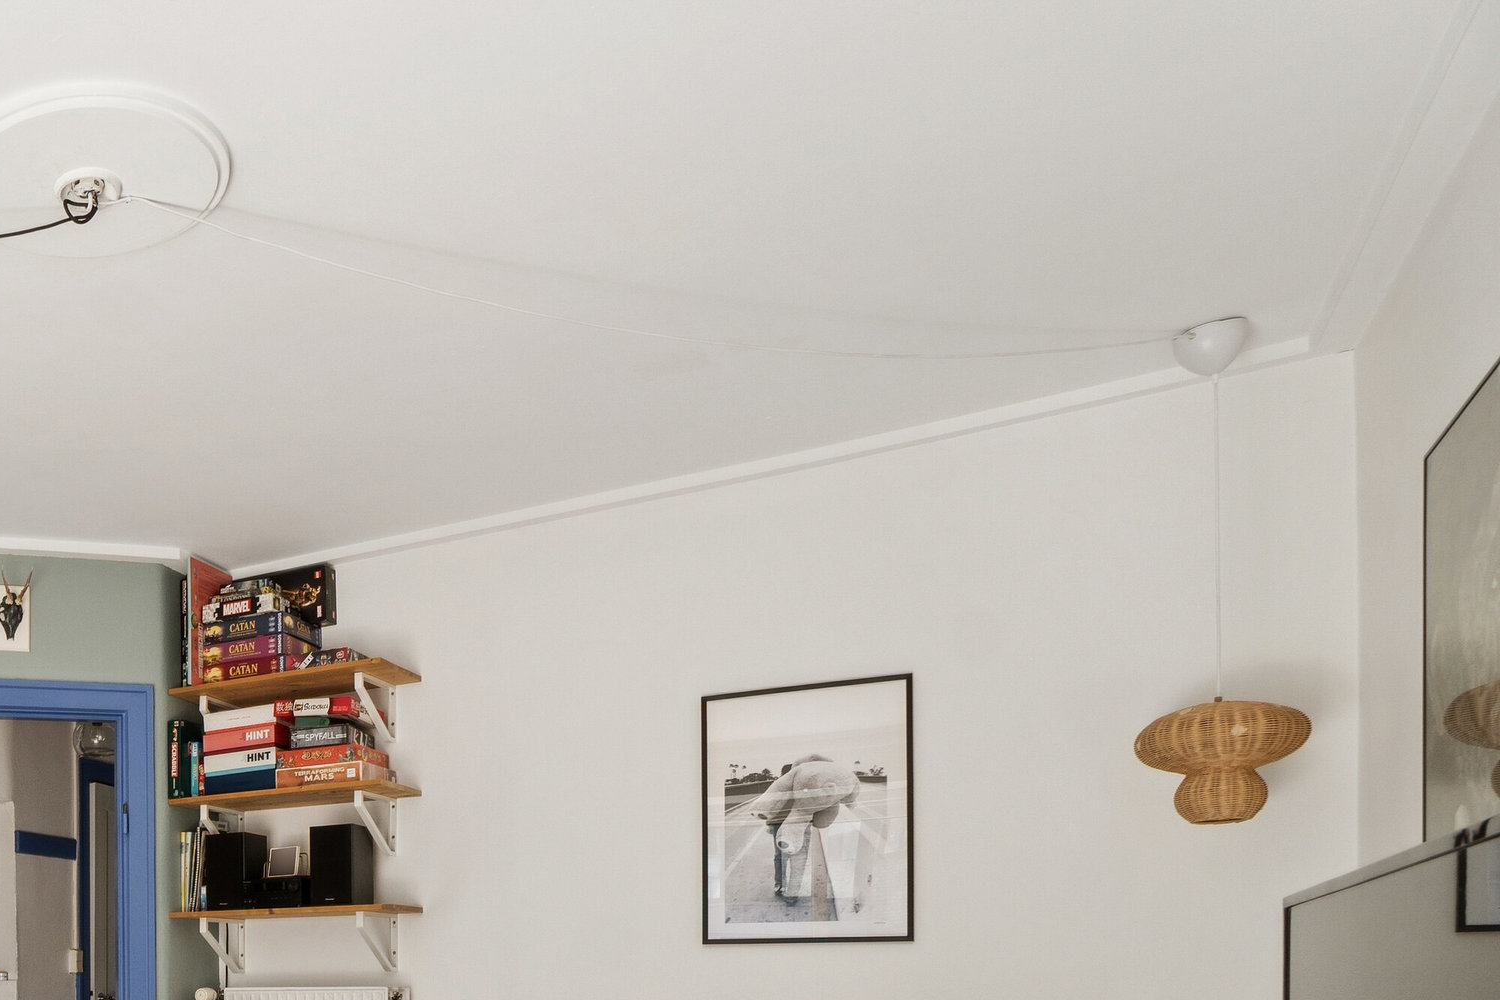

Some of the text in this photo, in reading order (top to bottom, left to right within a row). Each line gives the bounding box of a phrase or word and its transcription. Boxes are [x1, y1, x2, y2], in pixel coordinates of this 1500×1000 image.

[222, 600, 251, 616] MARVEL
[229, 620, 256, 633] CATAN
[228, 641, 255, 653] CATAN
[229, 663, 258, 676] CATAN
[245, 729, 270, 741] HINT
[304, 732, 336, 741] SPYFALL
[247, 751, 271, 763] HINT
[294, 767, 345, 777] TERRAFORMING
[304, 773, 335, 782] MARS
